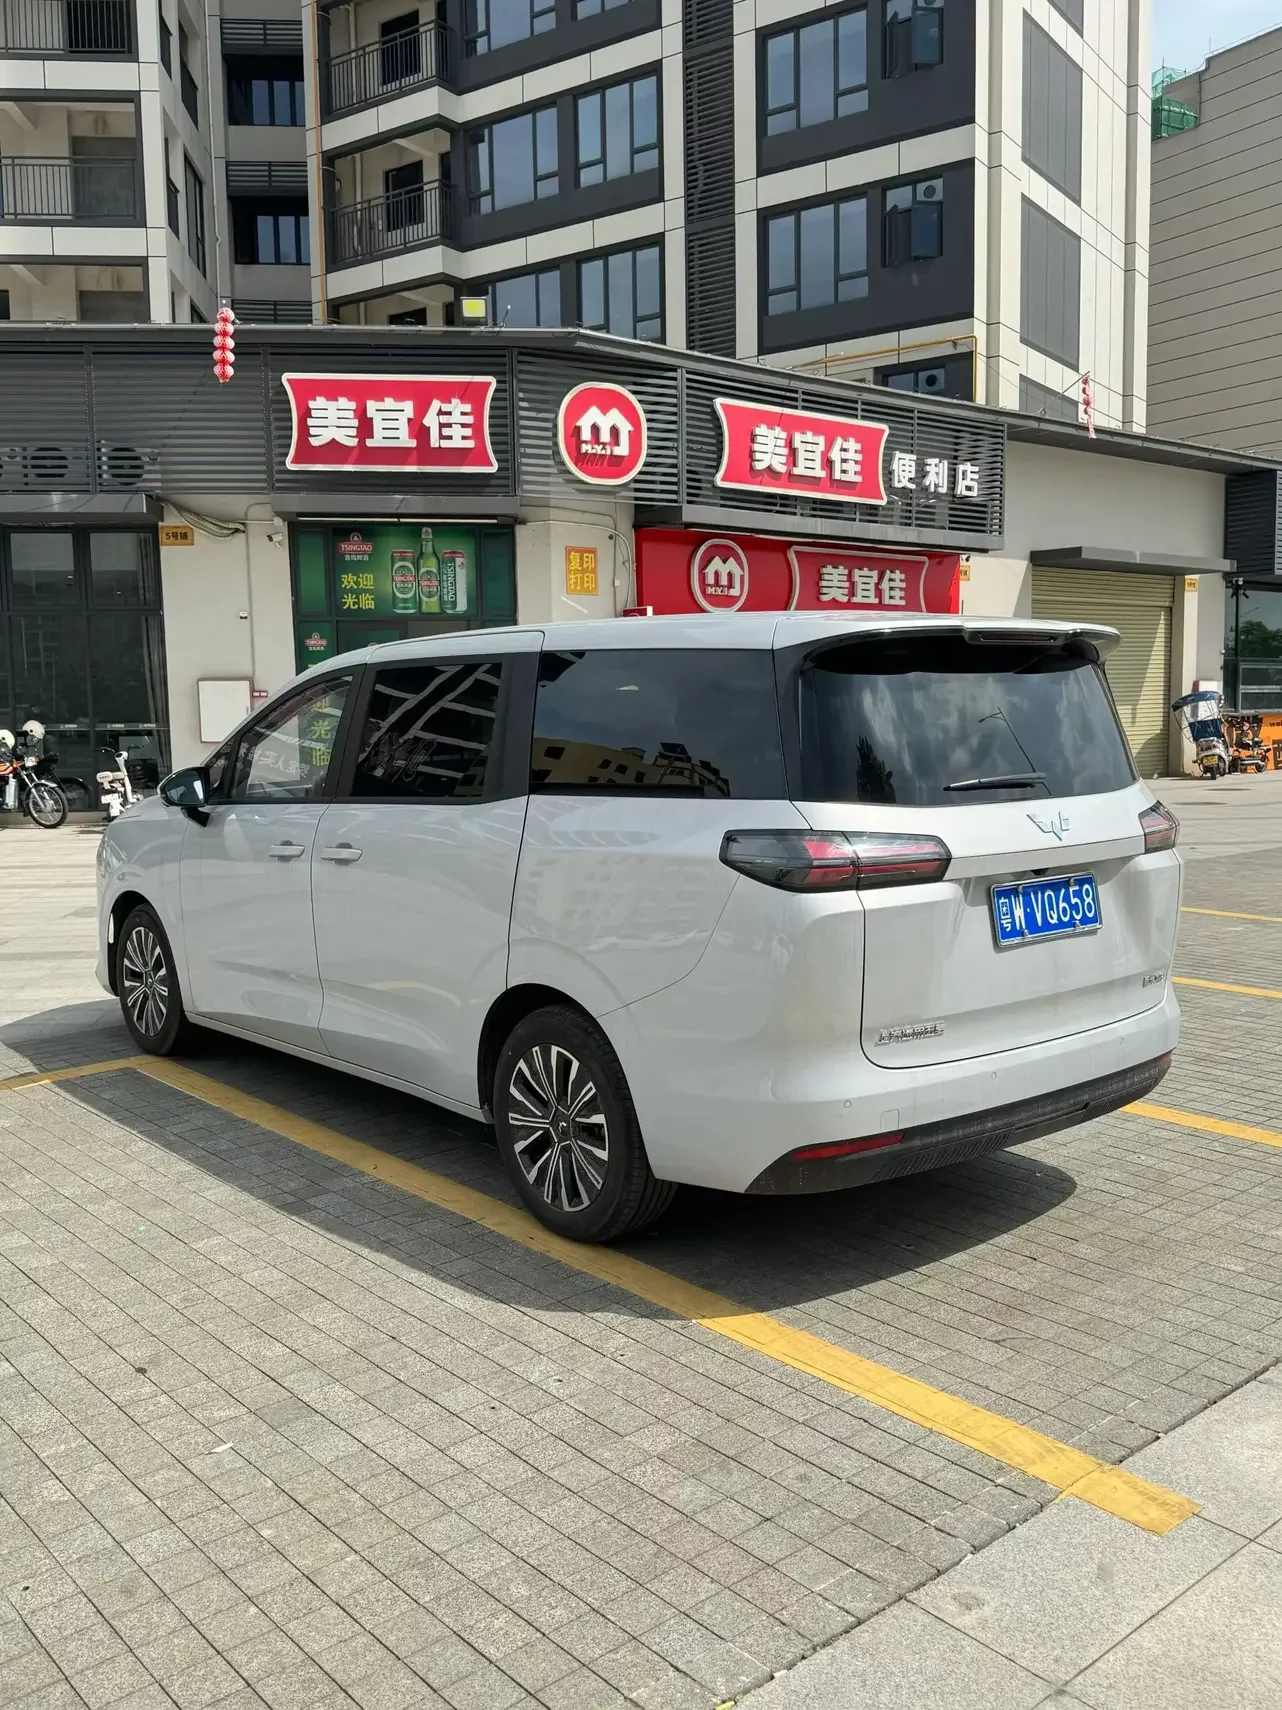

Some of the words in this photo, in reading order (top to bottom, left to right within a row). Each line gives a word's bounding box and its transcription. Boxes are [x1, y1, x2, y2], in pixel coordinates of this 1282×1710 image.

[307, 396, 475, 449] 美宜佳
[751, 424, 863, 483] 美宜佳
[890, 450, 980, 498] 便利店
[165, 531, 189, 541] 5号铺
[340, 543, 373, 552] TSINGTAO
[569, 551, 595, 571] 复印
[341, 572, 375, 590] 欢迎
[446, 562, 456, 602] TSINGTAO
[569, 571, 596, 591] 打印
[818, 564, 907, 606] 美宜佳
[342, 593, 375, 610] 光临
